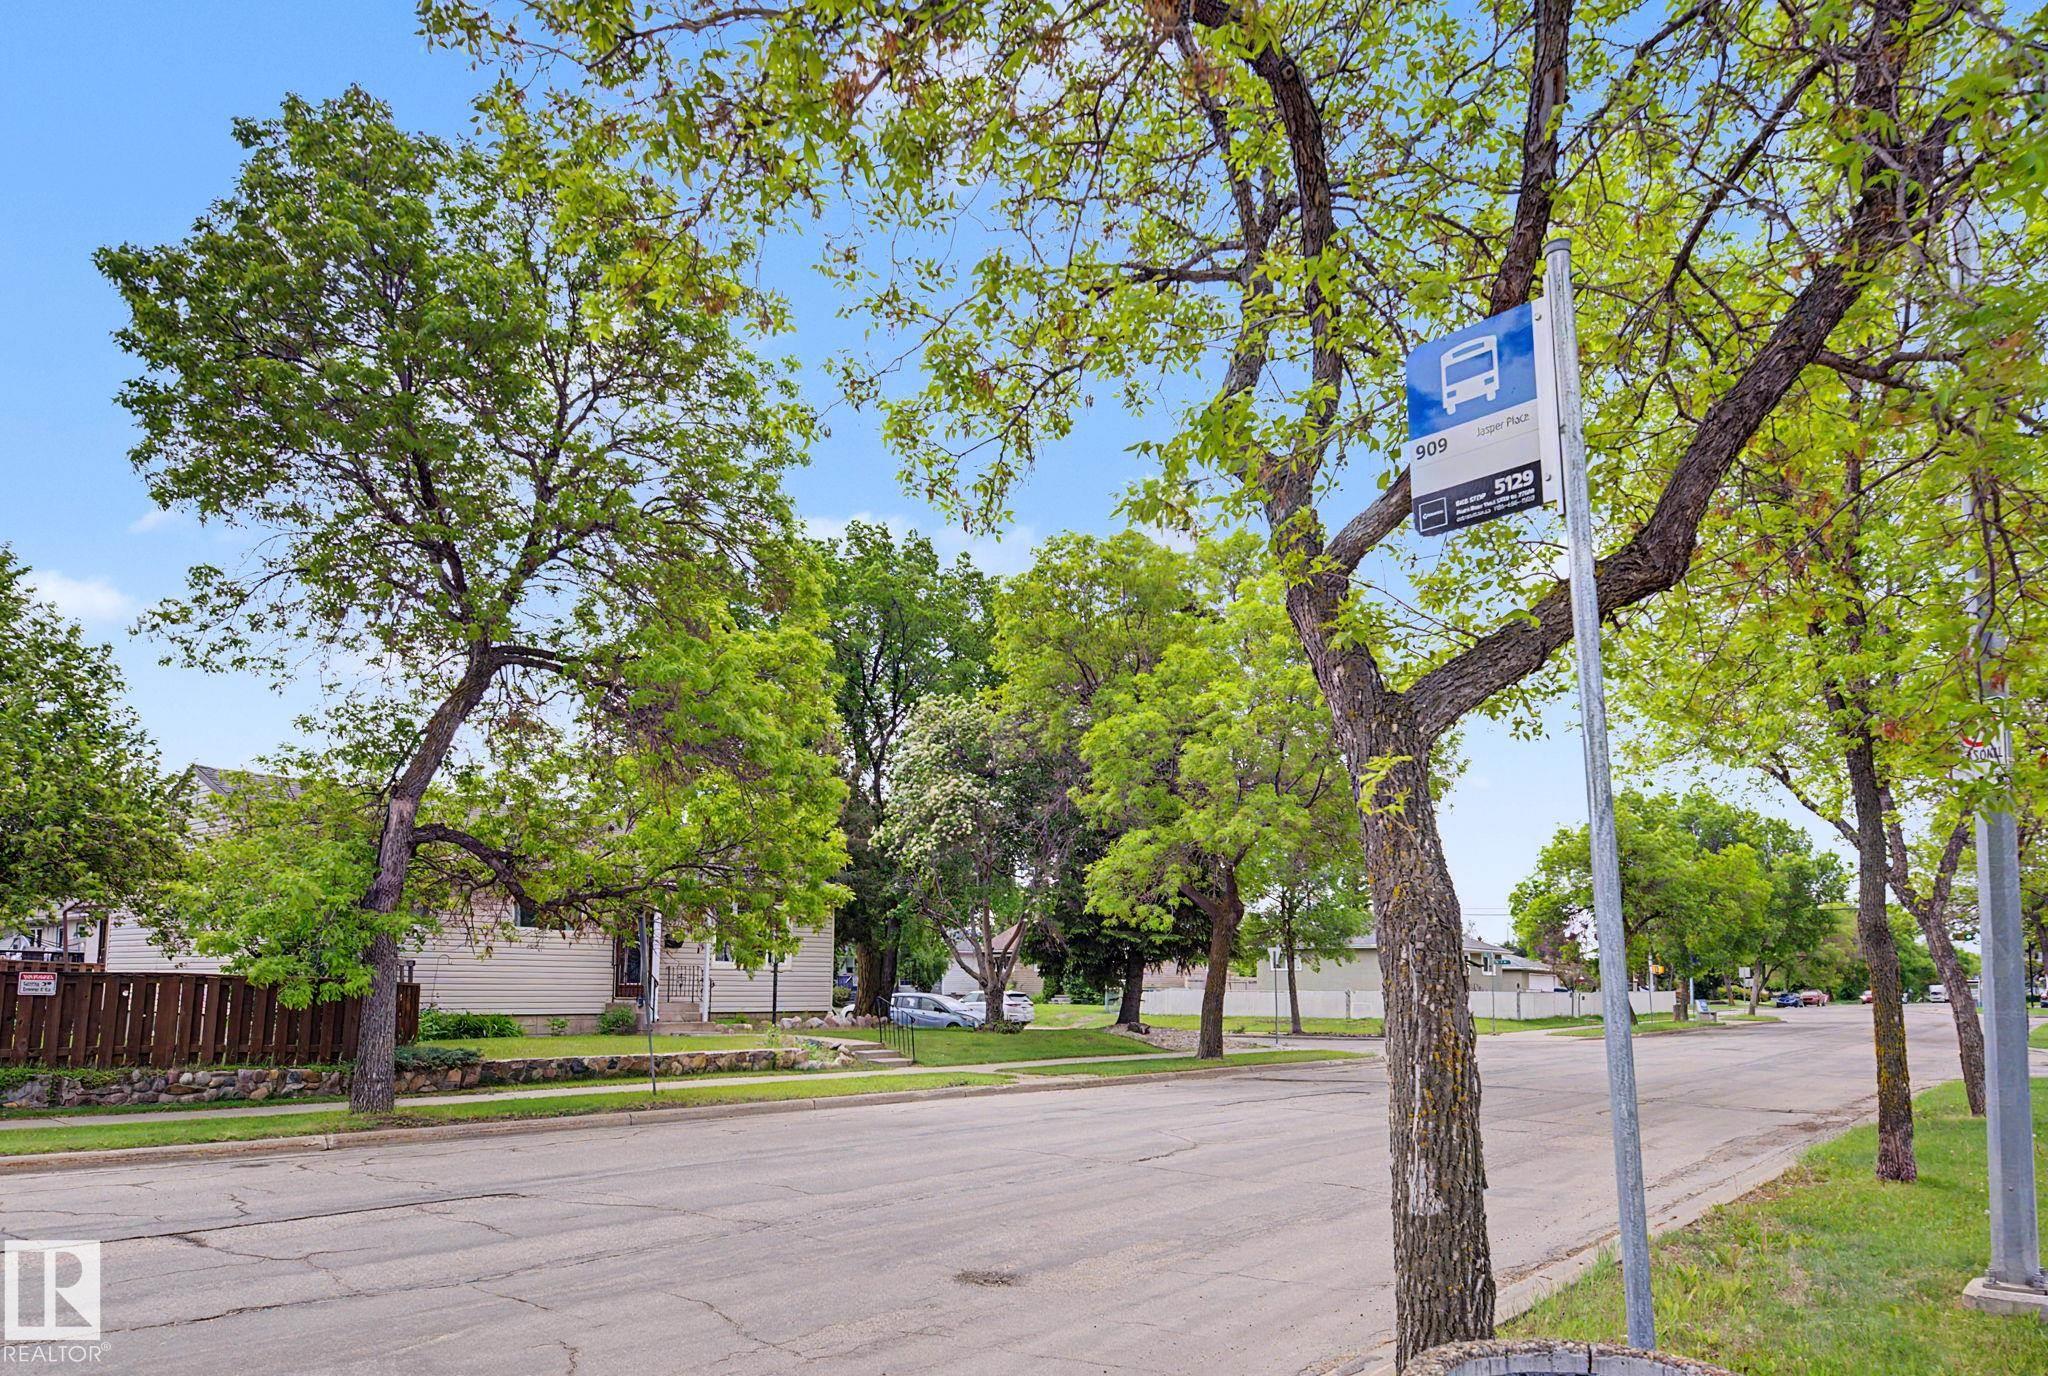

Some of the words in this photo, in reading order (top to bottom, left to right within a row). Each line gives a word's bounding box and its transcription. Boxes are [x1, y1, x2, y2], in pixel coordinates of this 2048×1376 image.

[1477, 421, 1504, 437] Jasper
[1506, 413, 1530, 427] Place
[1415, 437, 1448, 460] 909
[1494, 469, 1535, 496] 5129
